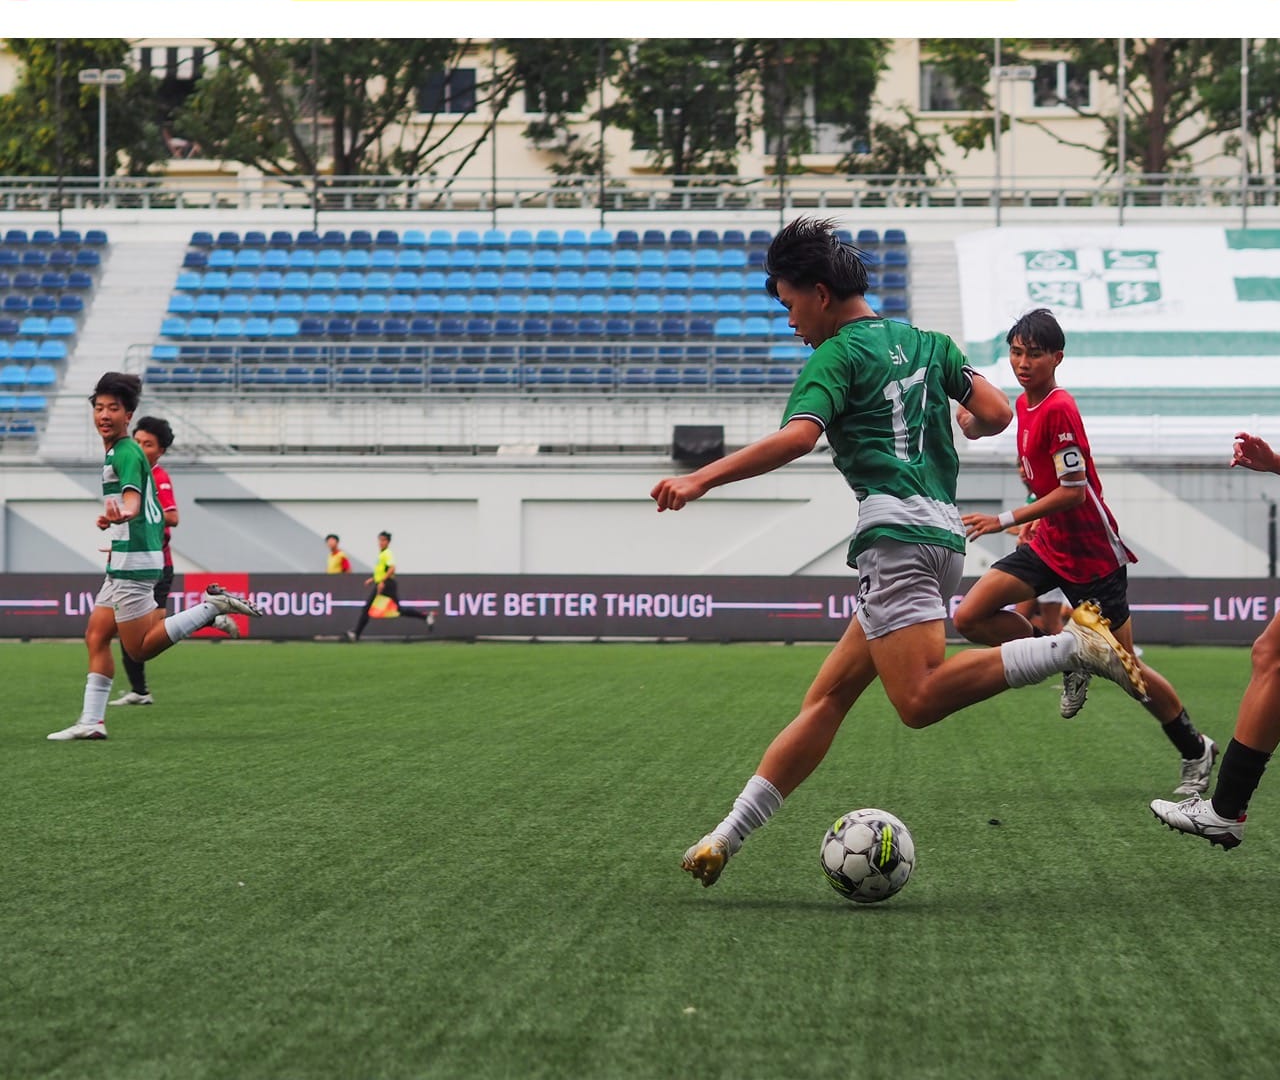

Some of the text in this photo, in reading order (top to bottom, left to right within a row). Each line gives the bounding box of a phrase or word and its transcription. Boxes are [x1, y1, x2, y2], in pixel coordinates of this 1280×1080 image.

[1063, 451, 1080, 468] C
[444, 593, 498, 617] LIVE
[503, 593, 598, 617] BETTER
[1213, 596, 1268, 621] LIVE
